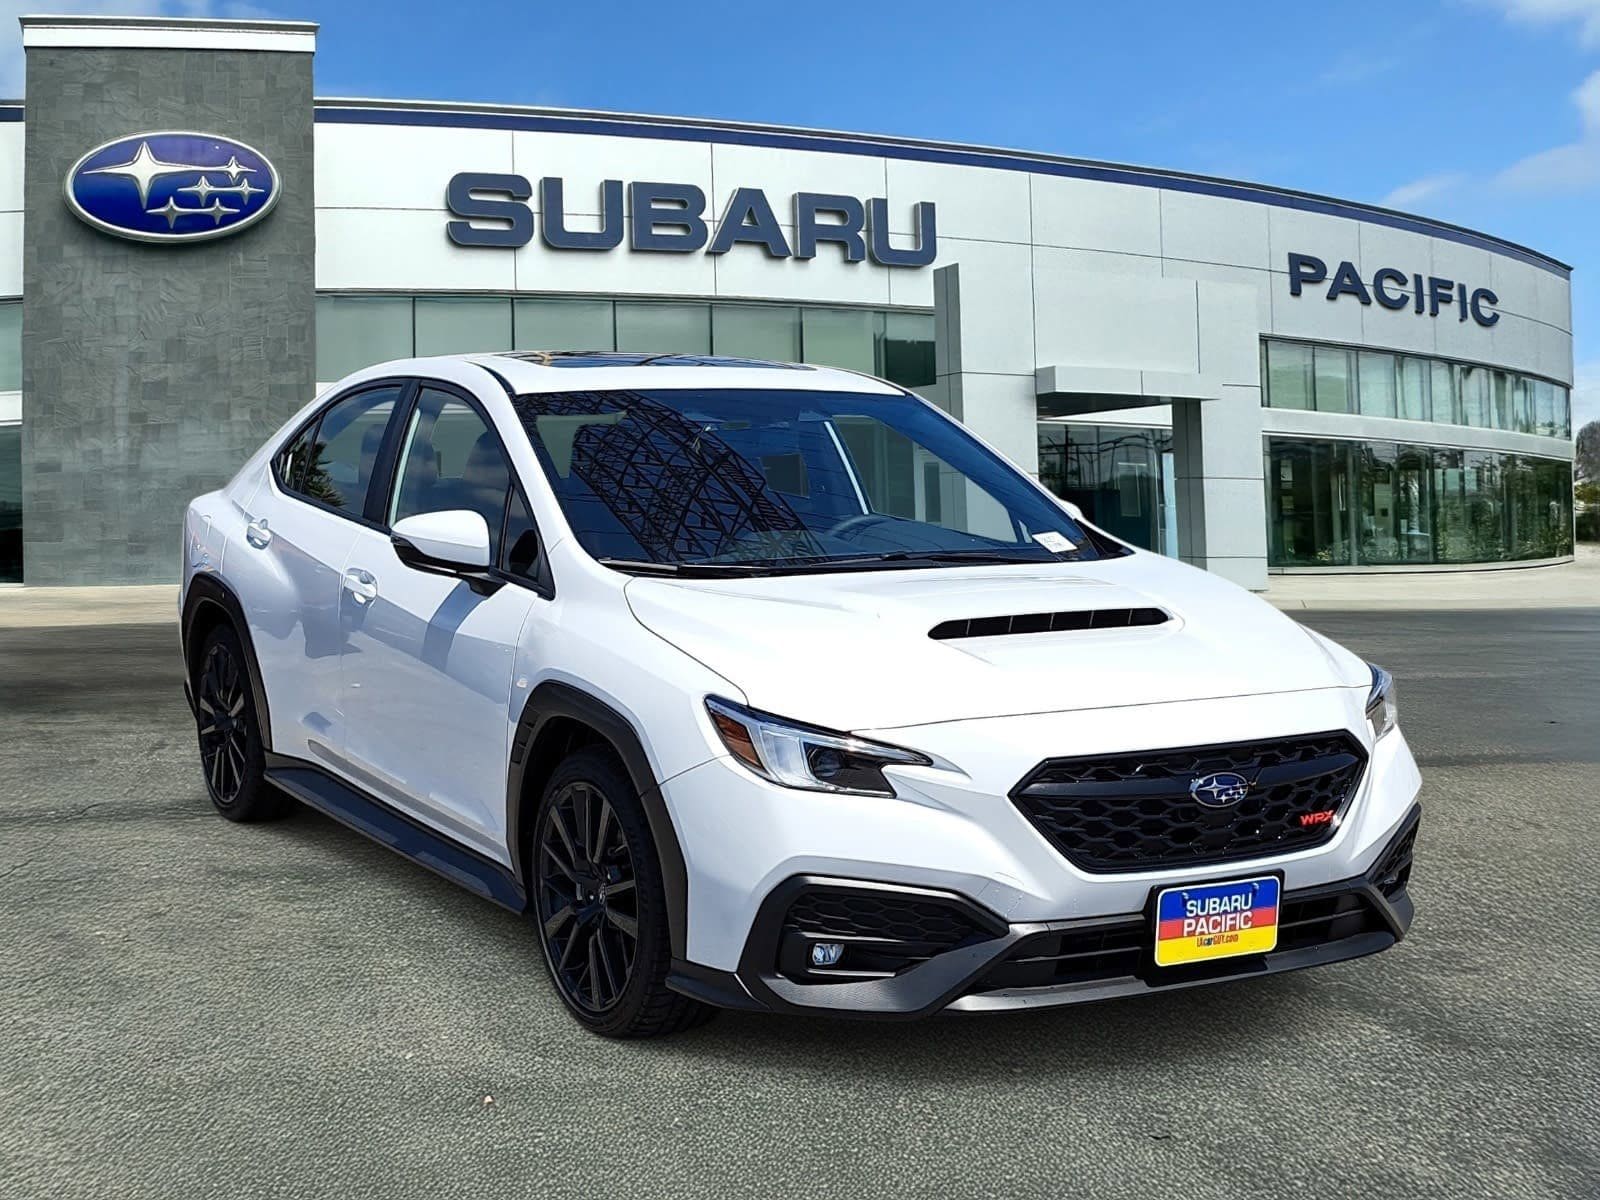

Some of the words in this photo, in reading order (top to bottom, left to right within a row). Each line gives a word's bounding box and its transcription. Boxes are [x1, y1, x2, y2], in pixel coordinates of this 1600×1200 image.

[447, 172, 936, 268] SUBARU
[1288, 252, 1500, 327] PACIFIC
[1300, 810, 1333, 825] WRX
[1186, 892, 1252, 917] SUBARU
[1183, 911, 1253, 936] PACIFIC
